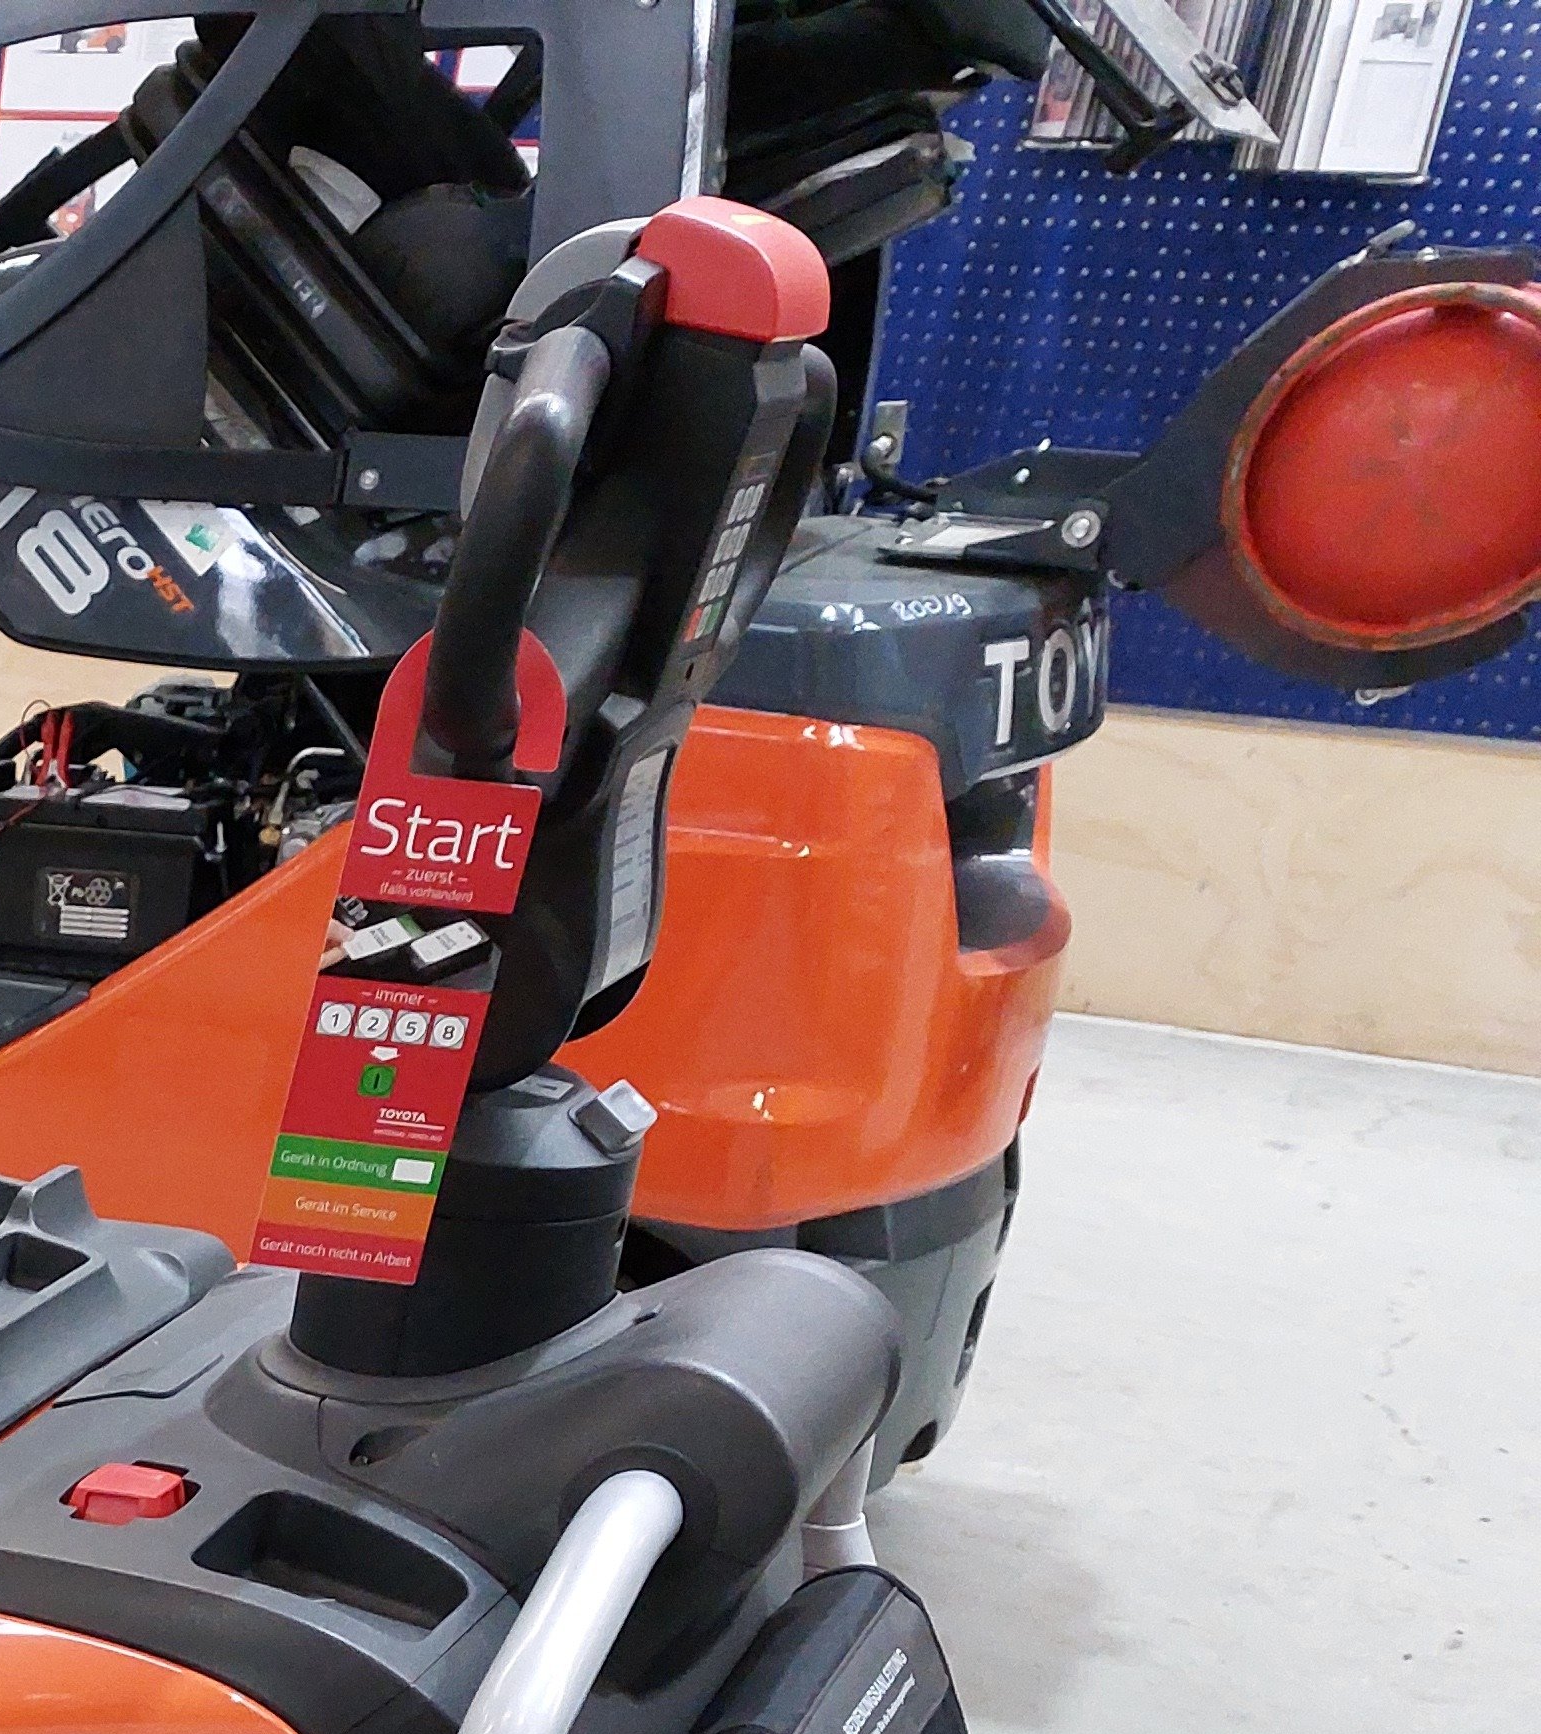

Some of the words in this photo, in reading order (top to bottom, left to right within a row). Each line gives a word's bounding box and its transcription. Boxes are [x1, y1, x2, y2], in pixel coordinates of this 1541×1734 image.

[360, 797, 523, 870] Start
[404, 868, 455, 886] zuerst
[374, 989, 425, 1006] immer
[379, 1107, 426, 1123] TOYOTA
[280, 1150, 315, 1167] Gerät
[319, 1155, 330, 1168] in
[333, 1157, 388, 1177] Ordnung
[295, 1196, 330, 1213] Gerät
[333, 1201, 349, 1216] im
[351, 1203, 397, 1221] Service
[260, 1237, 294, 1253] Gerät
[296, 1241, 325, 1258] noch
[328, 1245, 358, 1261] nicht
[360, 1249, 372, 1262] in
[374, 1250, 411, 1267] Arbeit
